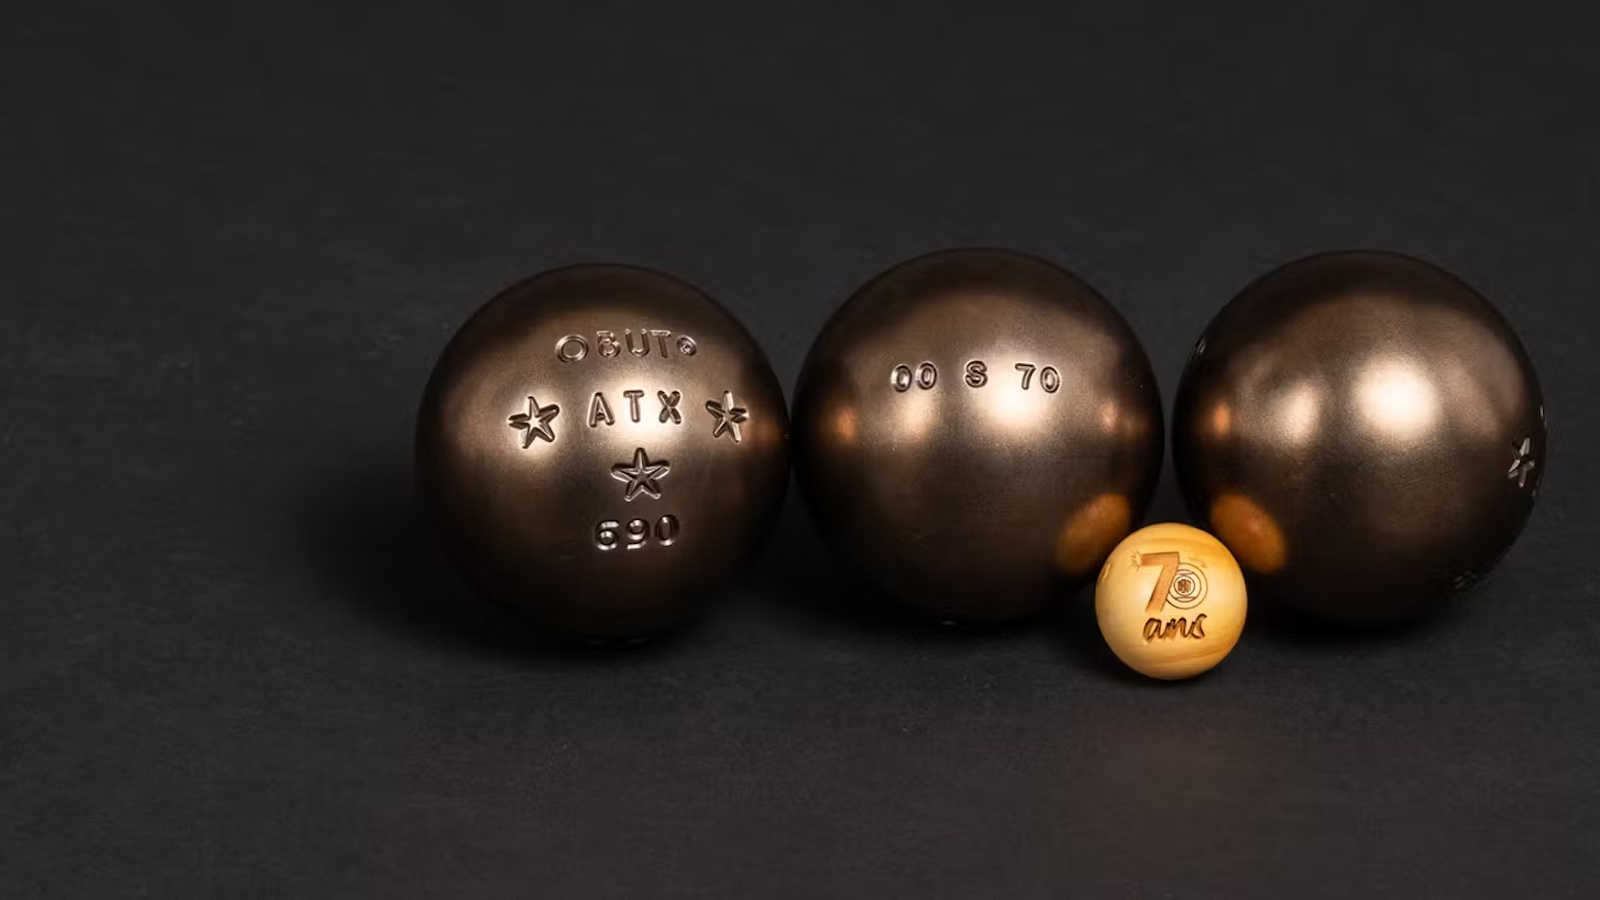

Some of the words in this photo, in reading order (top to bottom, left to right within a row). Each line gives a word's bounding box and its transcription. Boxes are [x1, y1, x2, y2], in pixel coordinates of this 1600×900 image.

[891, 361, 938, 393] 00
[964, 360, 988, 389] S
[1015, 362, 1061, 393] 70
[589, 390, 682, 427] ATX
[595, 515, 680, 550] 690
[1143, 613, 1207, 641] ans
